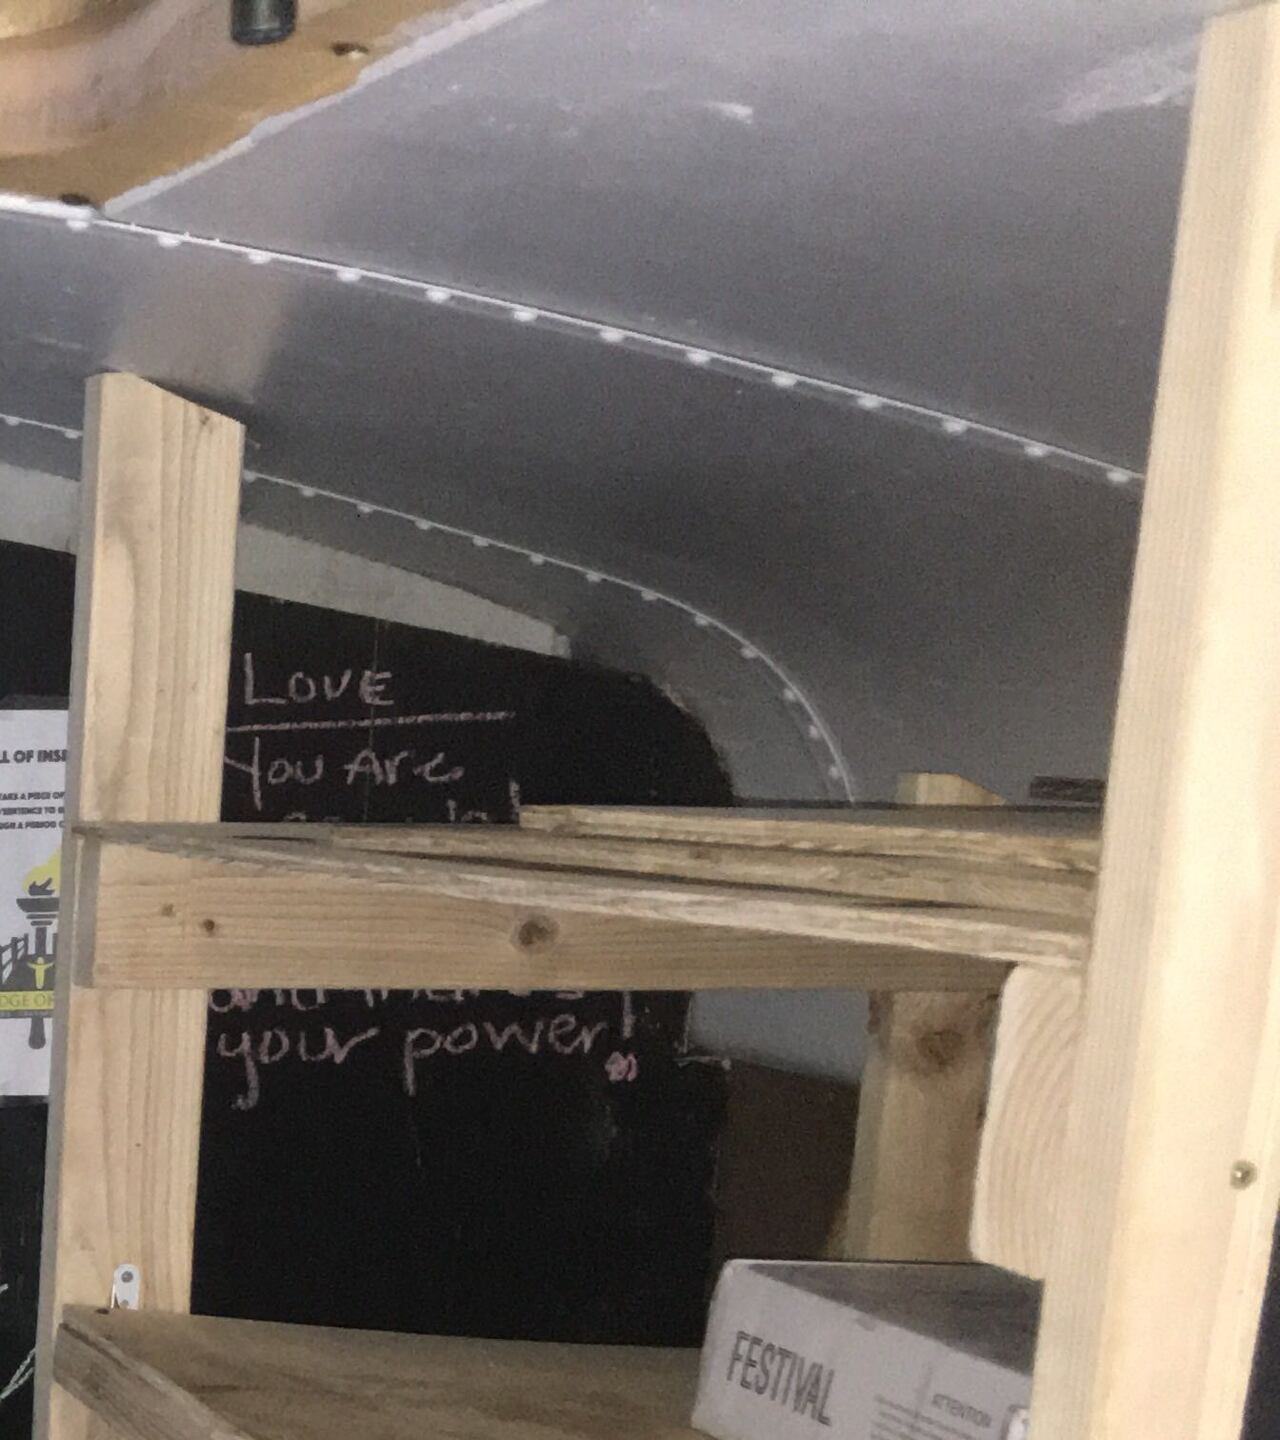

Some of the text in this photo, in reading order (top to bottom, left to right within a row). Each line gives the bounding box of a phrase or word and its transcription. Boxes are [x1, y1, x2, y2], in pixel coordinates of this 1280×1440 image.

[13, 749, 34, 763] OF
[216, 1024, 378, 1111] your
[725, 1330, 836, 1427] FESTIVAL
